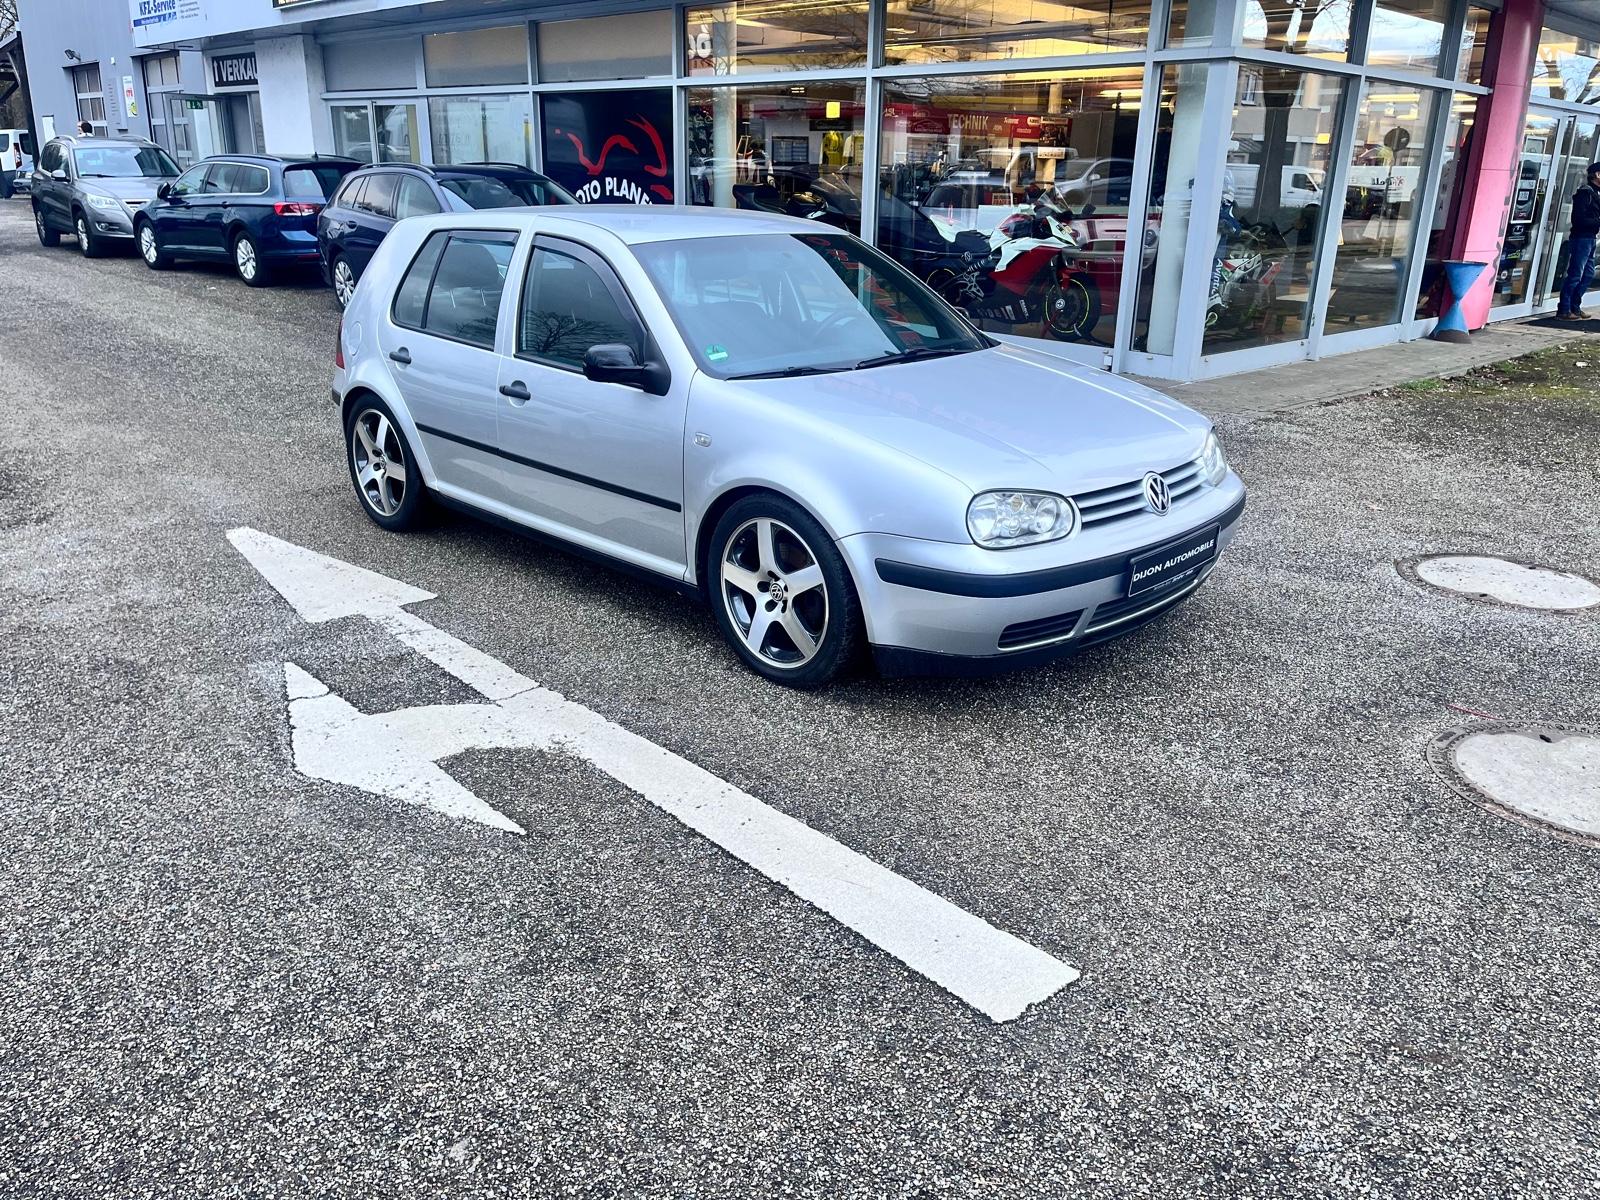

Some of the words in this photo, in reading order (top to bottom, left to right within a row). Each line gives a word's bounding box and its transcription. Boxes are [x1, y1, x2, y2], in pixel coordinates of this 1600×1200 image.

[947, 113, 989, 130] TECHNIK
[1132, 563, 1163, 582] DIJON
[1163, 538, 1215, 570] AUTOMOBILE
